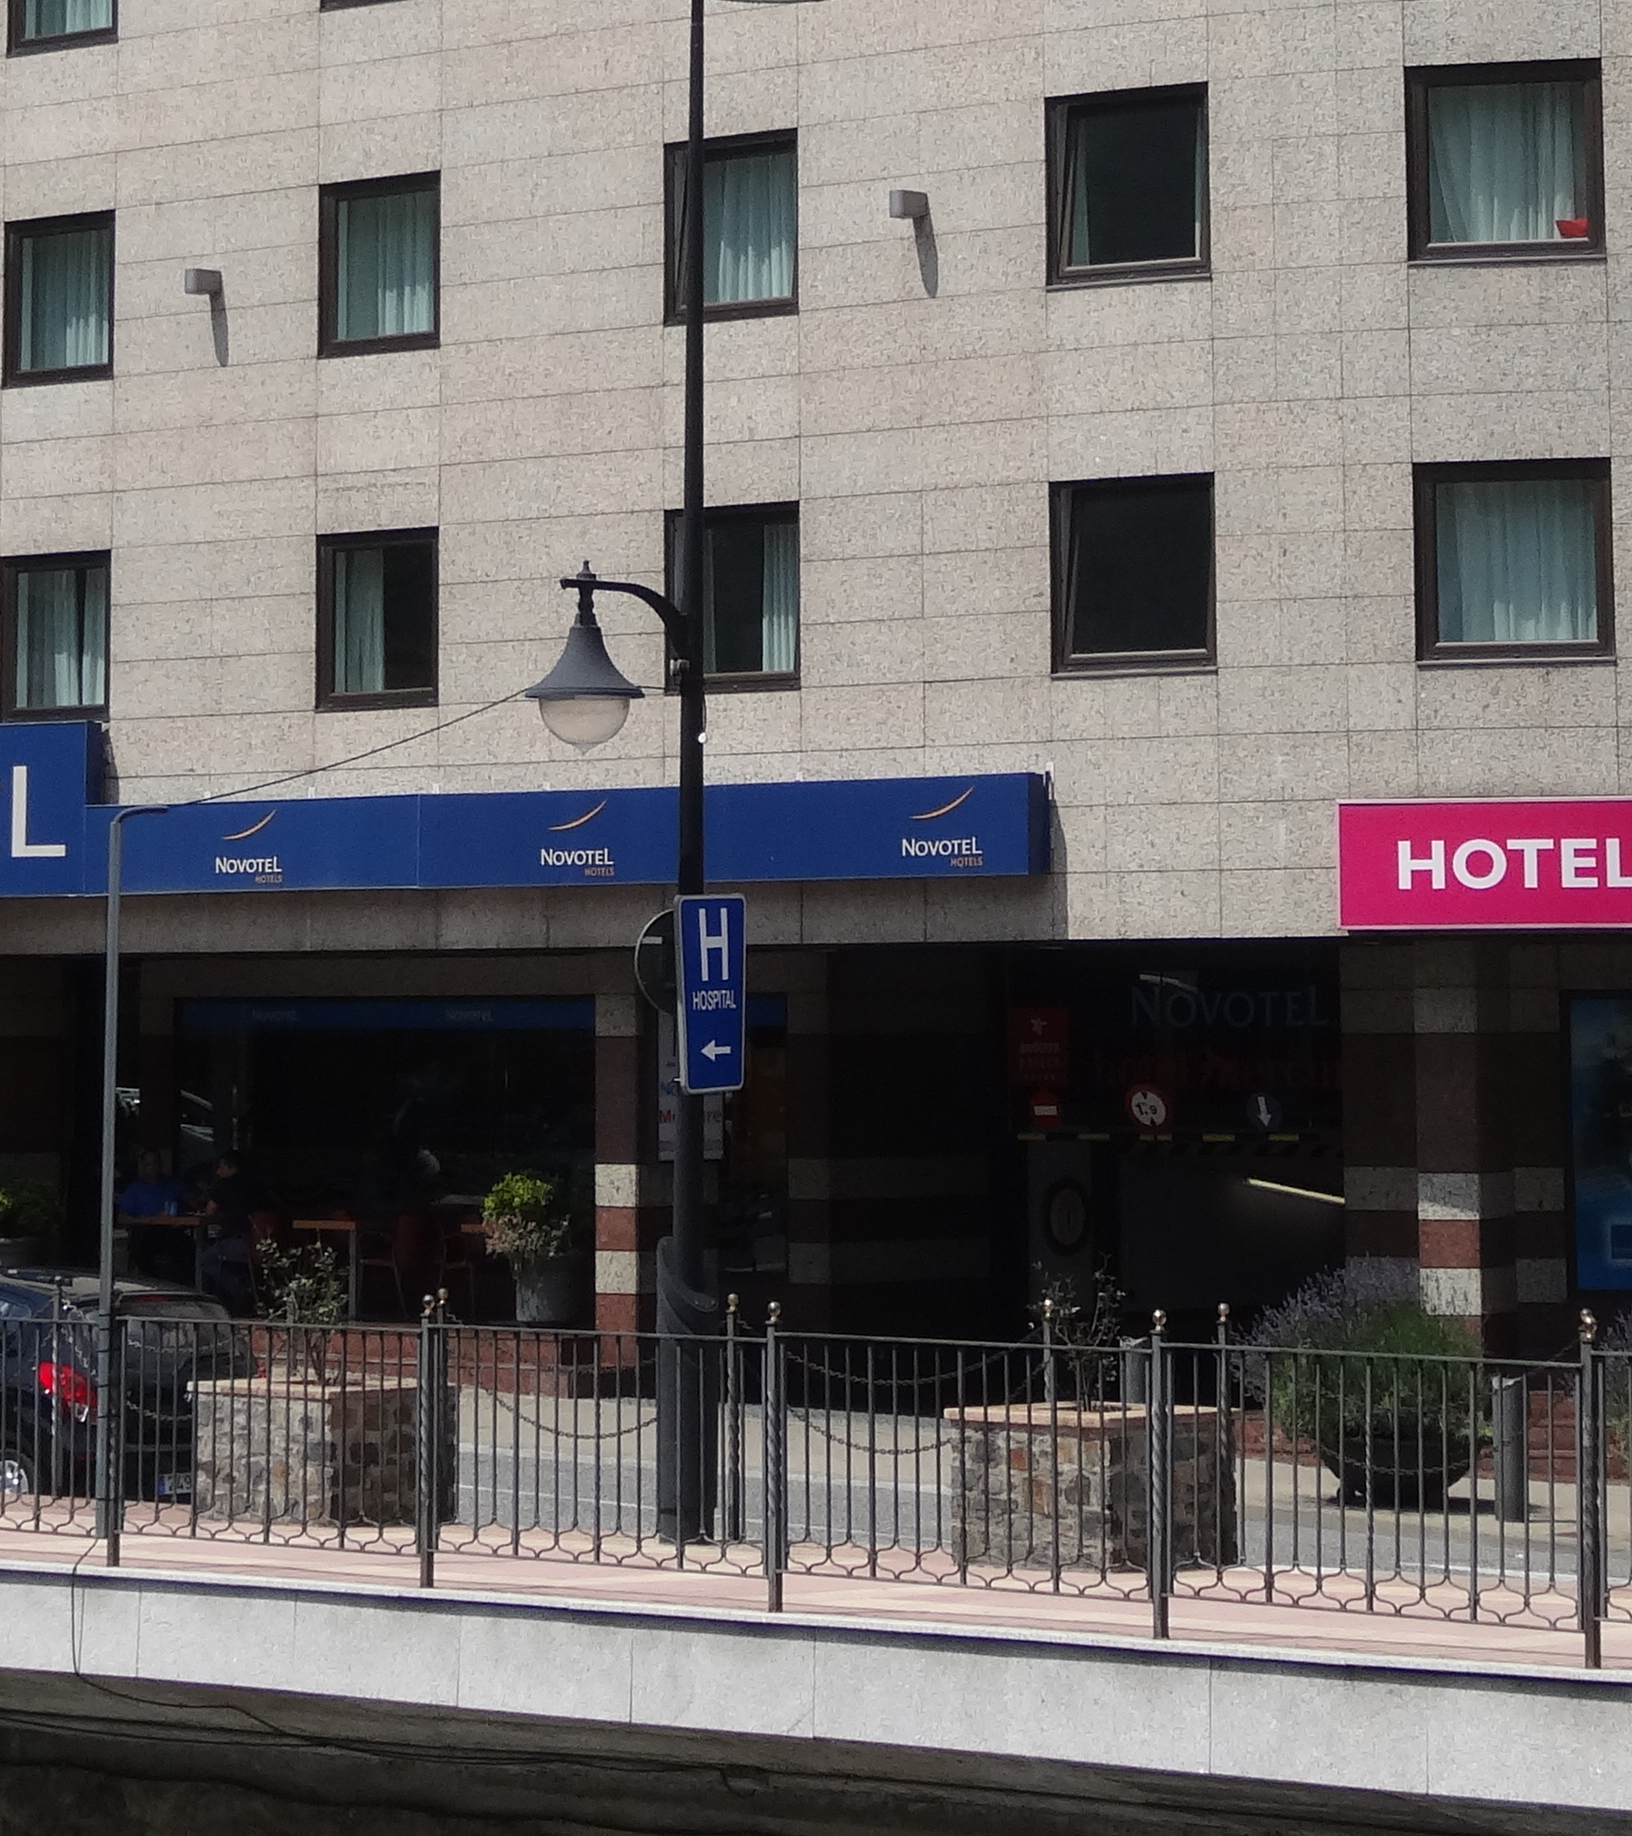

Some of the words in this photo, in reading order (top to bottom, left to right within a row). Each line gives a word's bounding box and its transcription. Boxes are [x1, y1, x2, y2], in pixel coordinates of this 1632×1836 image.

[901, 836, 983, 857] NOVOTEL
[215, 856, 282, 874] NOVOTEL
[540, 848, 614, 866] NOVOTEL
[950, 857, 983, 867] HOTELS
[698, 907, 730, 982] H
[692, 989, 737, 1011] HOSPITAL
